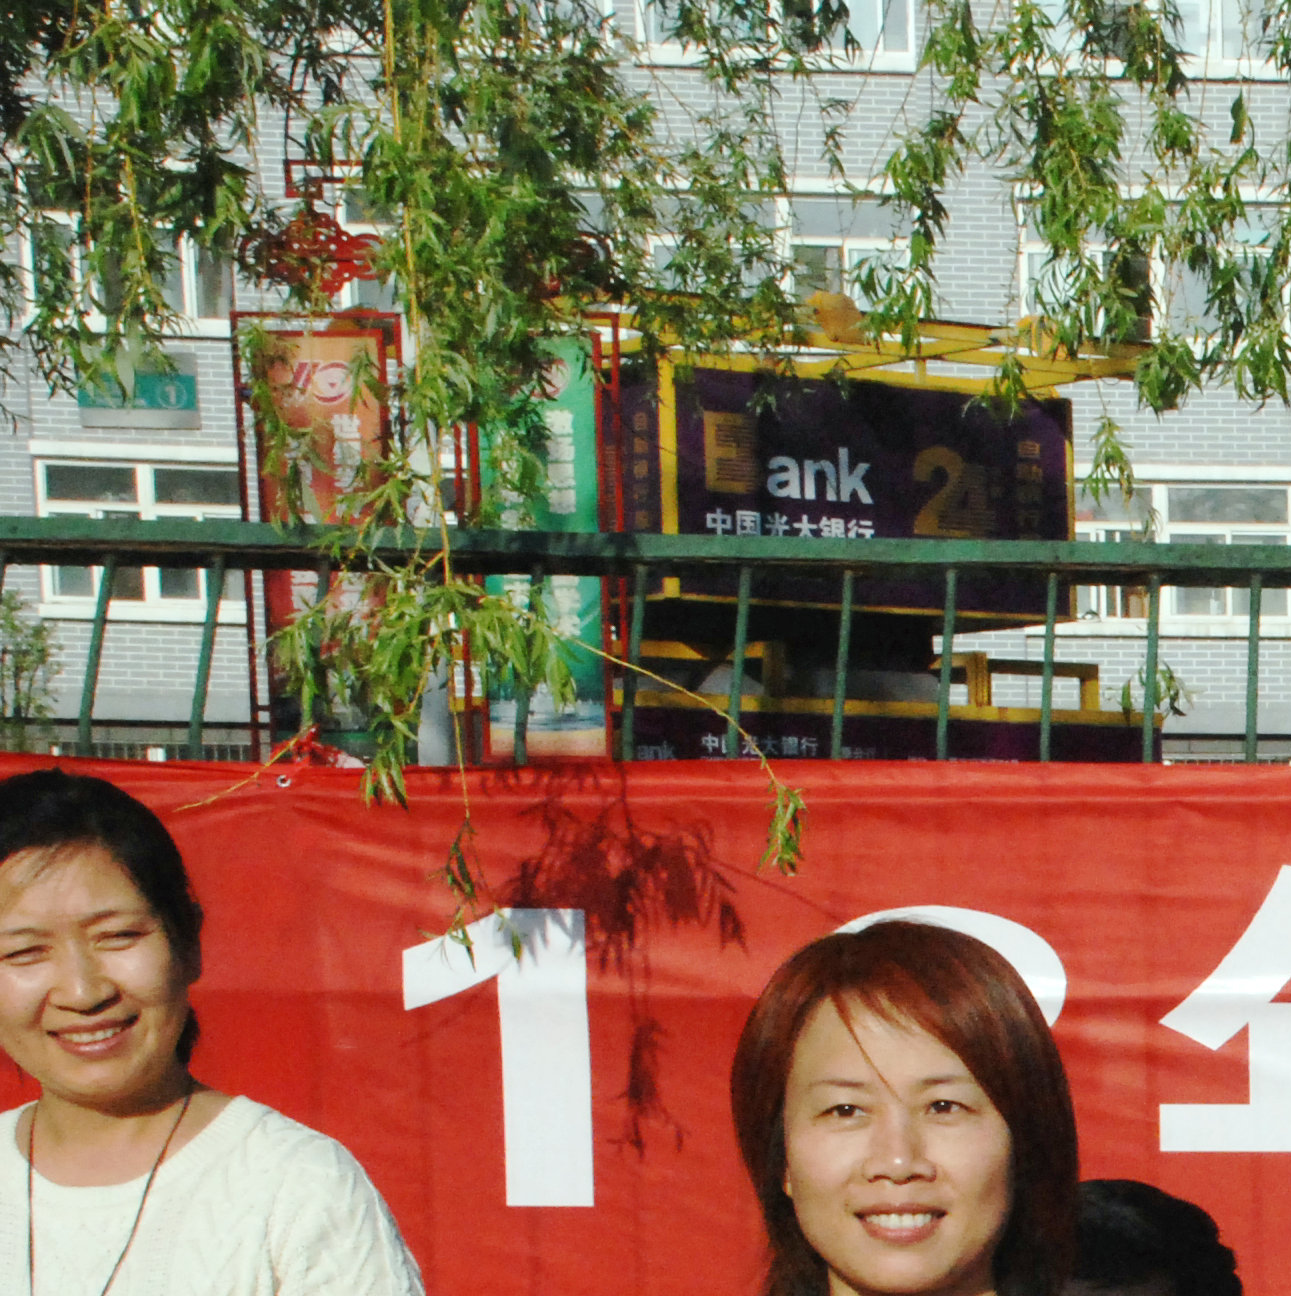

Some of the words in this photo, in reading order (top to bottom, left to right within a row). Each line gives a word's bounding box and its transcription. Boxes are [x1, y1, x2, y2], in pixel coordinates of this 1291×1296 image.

[705, 507, 875, 538] 中国光大银行
[701, 732, 819, 756] 中光大银行
